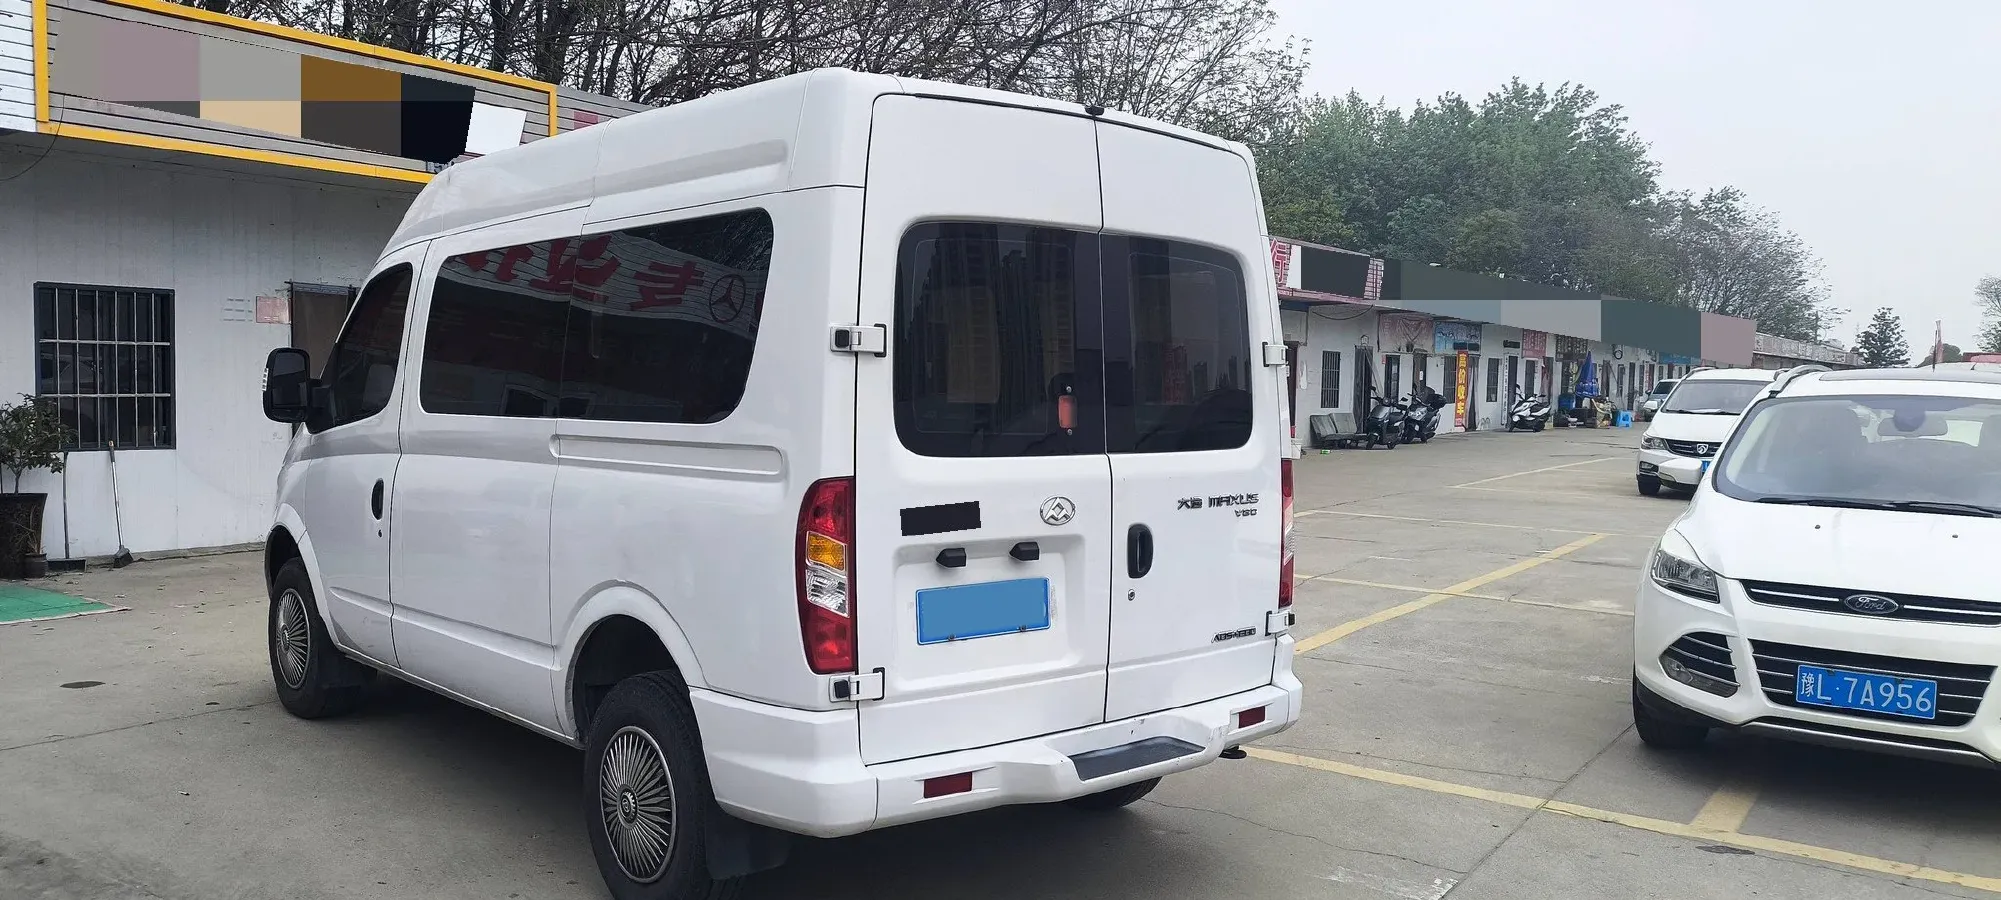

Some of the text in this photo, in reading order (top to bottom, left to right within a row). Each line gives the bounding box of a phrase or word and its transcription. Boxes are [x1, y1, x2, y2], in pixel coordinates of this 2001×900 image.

[1456, 353, 1467, 415] 高价收车
[1208, 493, 1259, 508] MAXUS
[1855, 596, 1884, 611] Ford
